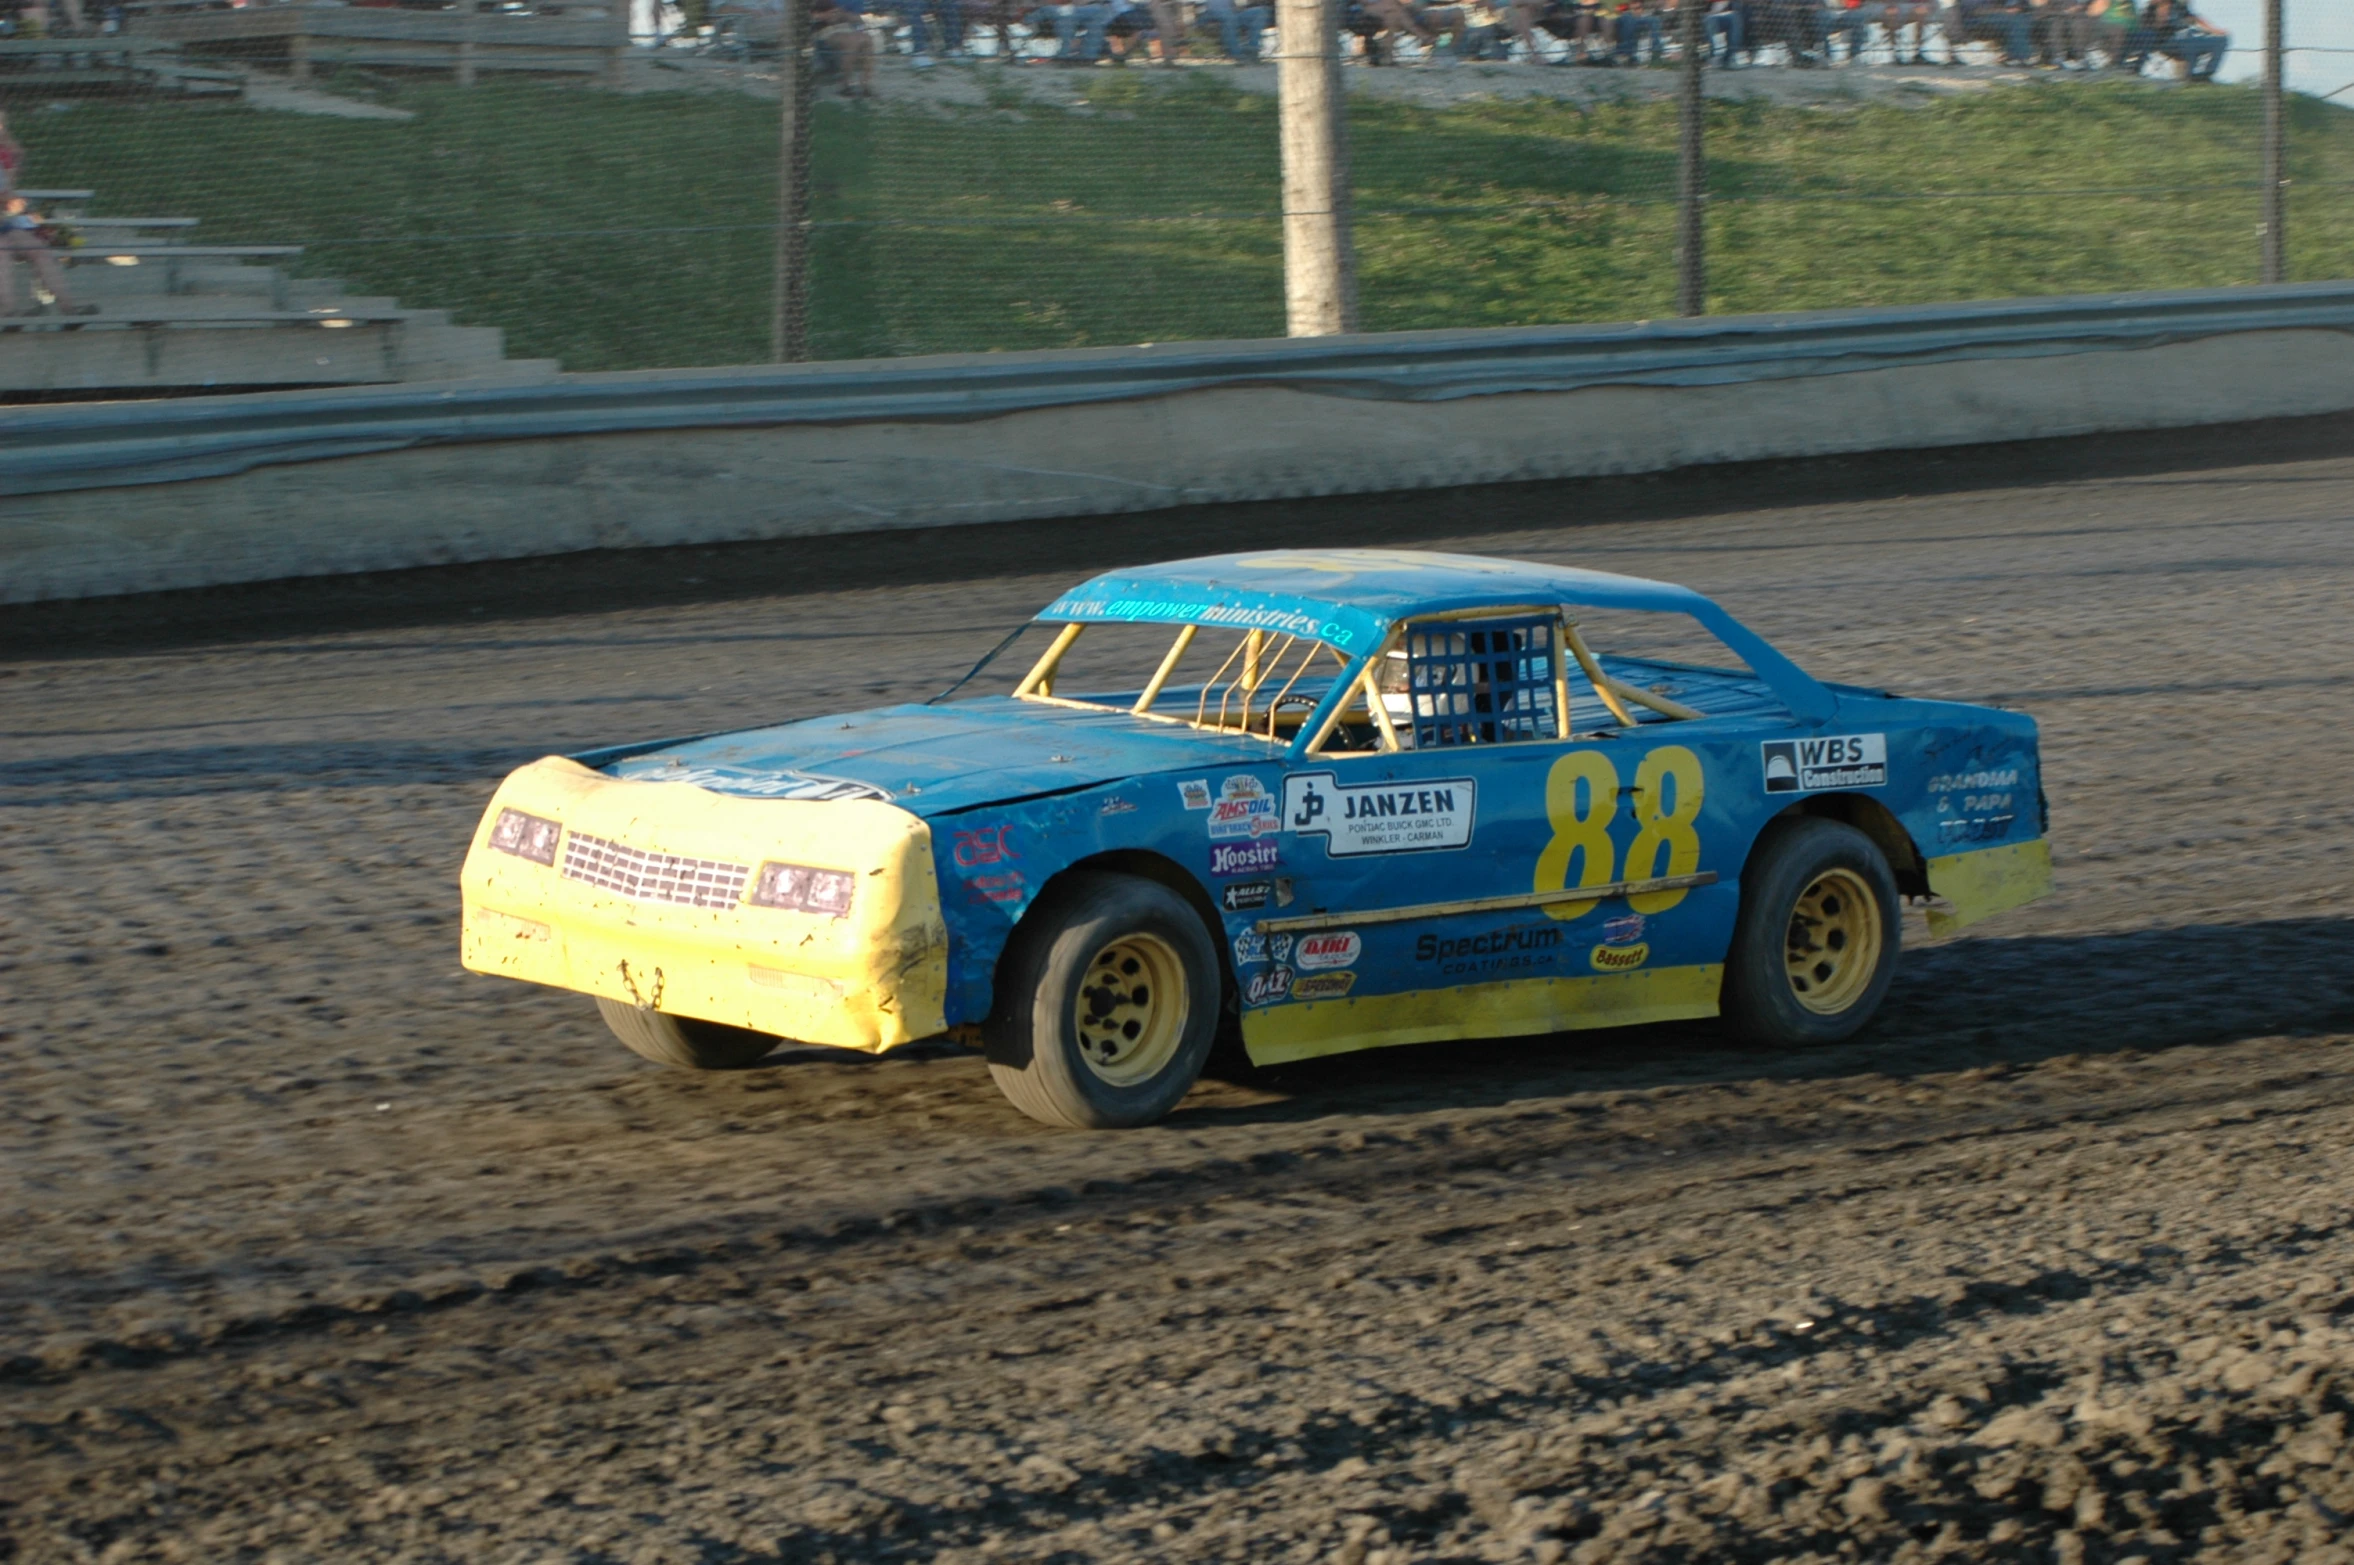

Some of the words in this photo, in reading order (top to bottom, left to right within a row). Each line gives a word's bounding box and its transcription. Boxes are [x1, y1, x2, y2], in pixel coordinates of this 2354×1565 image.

[1800, 737, 1863, 765] WBS
[1803, 765, 1884, 788] Construction
[1927, 768, 2018, 793] GRANDMA
[1214, 798, 1272, 821] AMSOIL
[1344, 788, 1455, 819] JANZEN
[1962, 792, 2013, 812] PAPA
[1348, 821, 1386, 833] PONTIAC
[1387, 819, 1413, 831] BUICK
[1414, 818, 1434, 829] GMC
[1361, 833, 1401, 845] WINKLER
[1407, 830, 1444, 842] CARMAN
[1533, 744, 1704, 921] 88
[1211, 842, 1278, 873] Hoosier
[1415, 927, 1561, 965] Spectrum
[1596, 948, 1644, 966] Bassett
